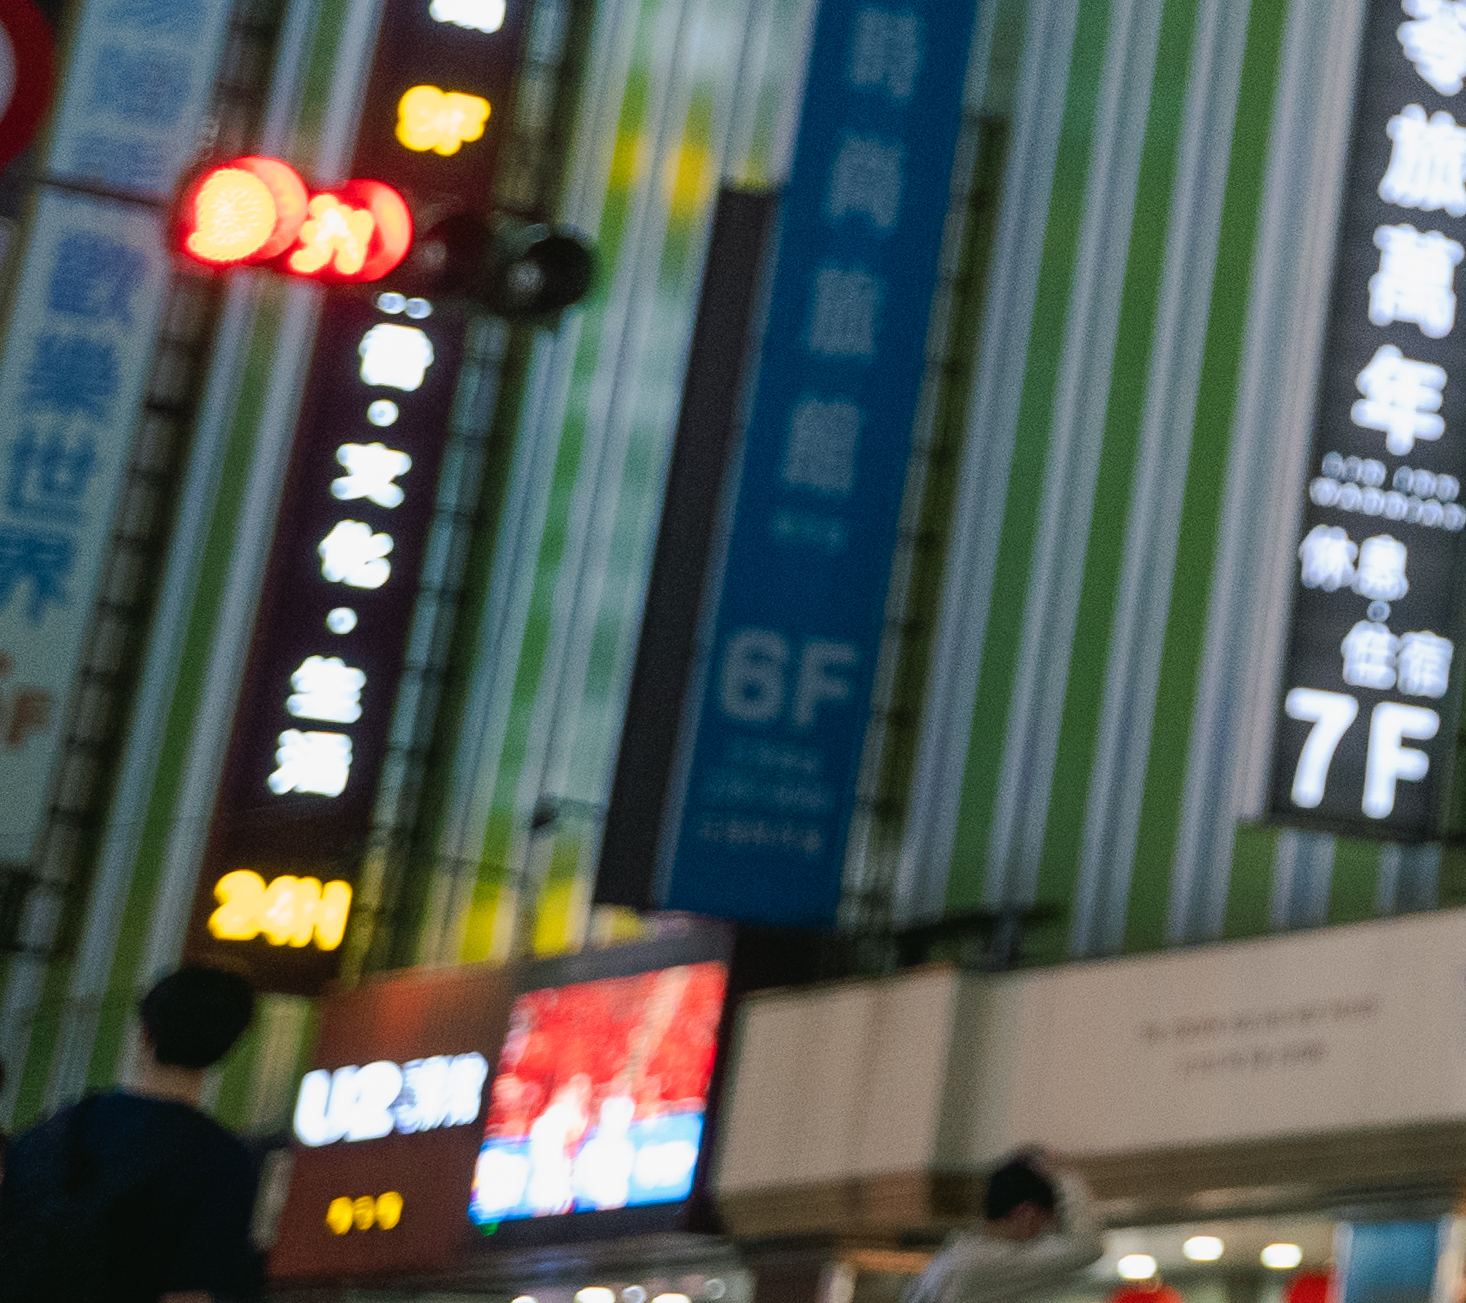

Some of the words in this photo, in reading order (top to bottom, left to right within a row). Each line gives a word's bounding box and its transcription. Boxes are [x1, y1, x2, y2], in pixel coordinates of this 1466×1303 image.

[716, 629, 858, 727] 6F
[1284, 686, 1441, 819] 7F
[208, 870, 352, 951] 24H
